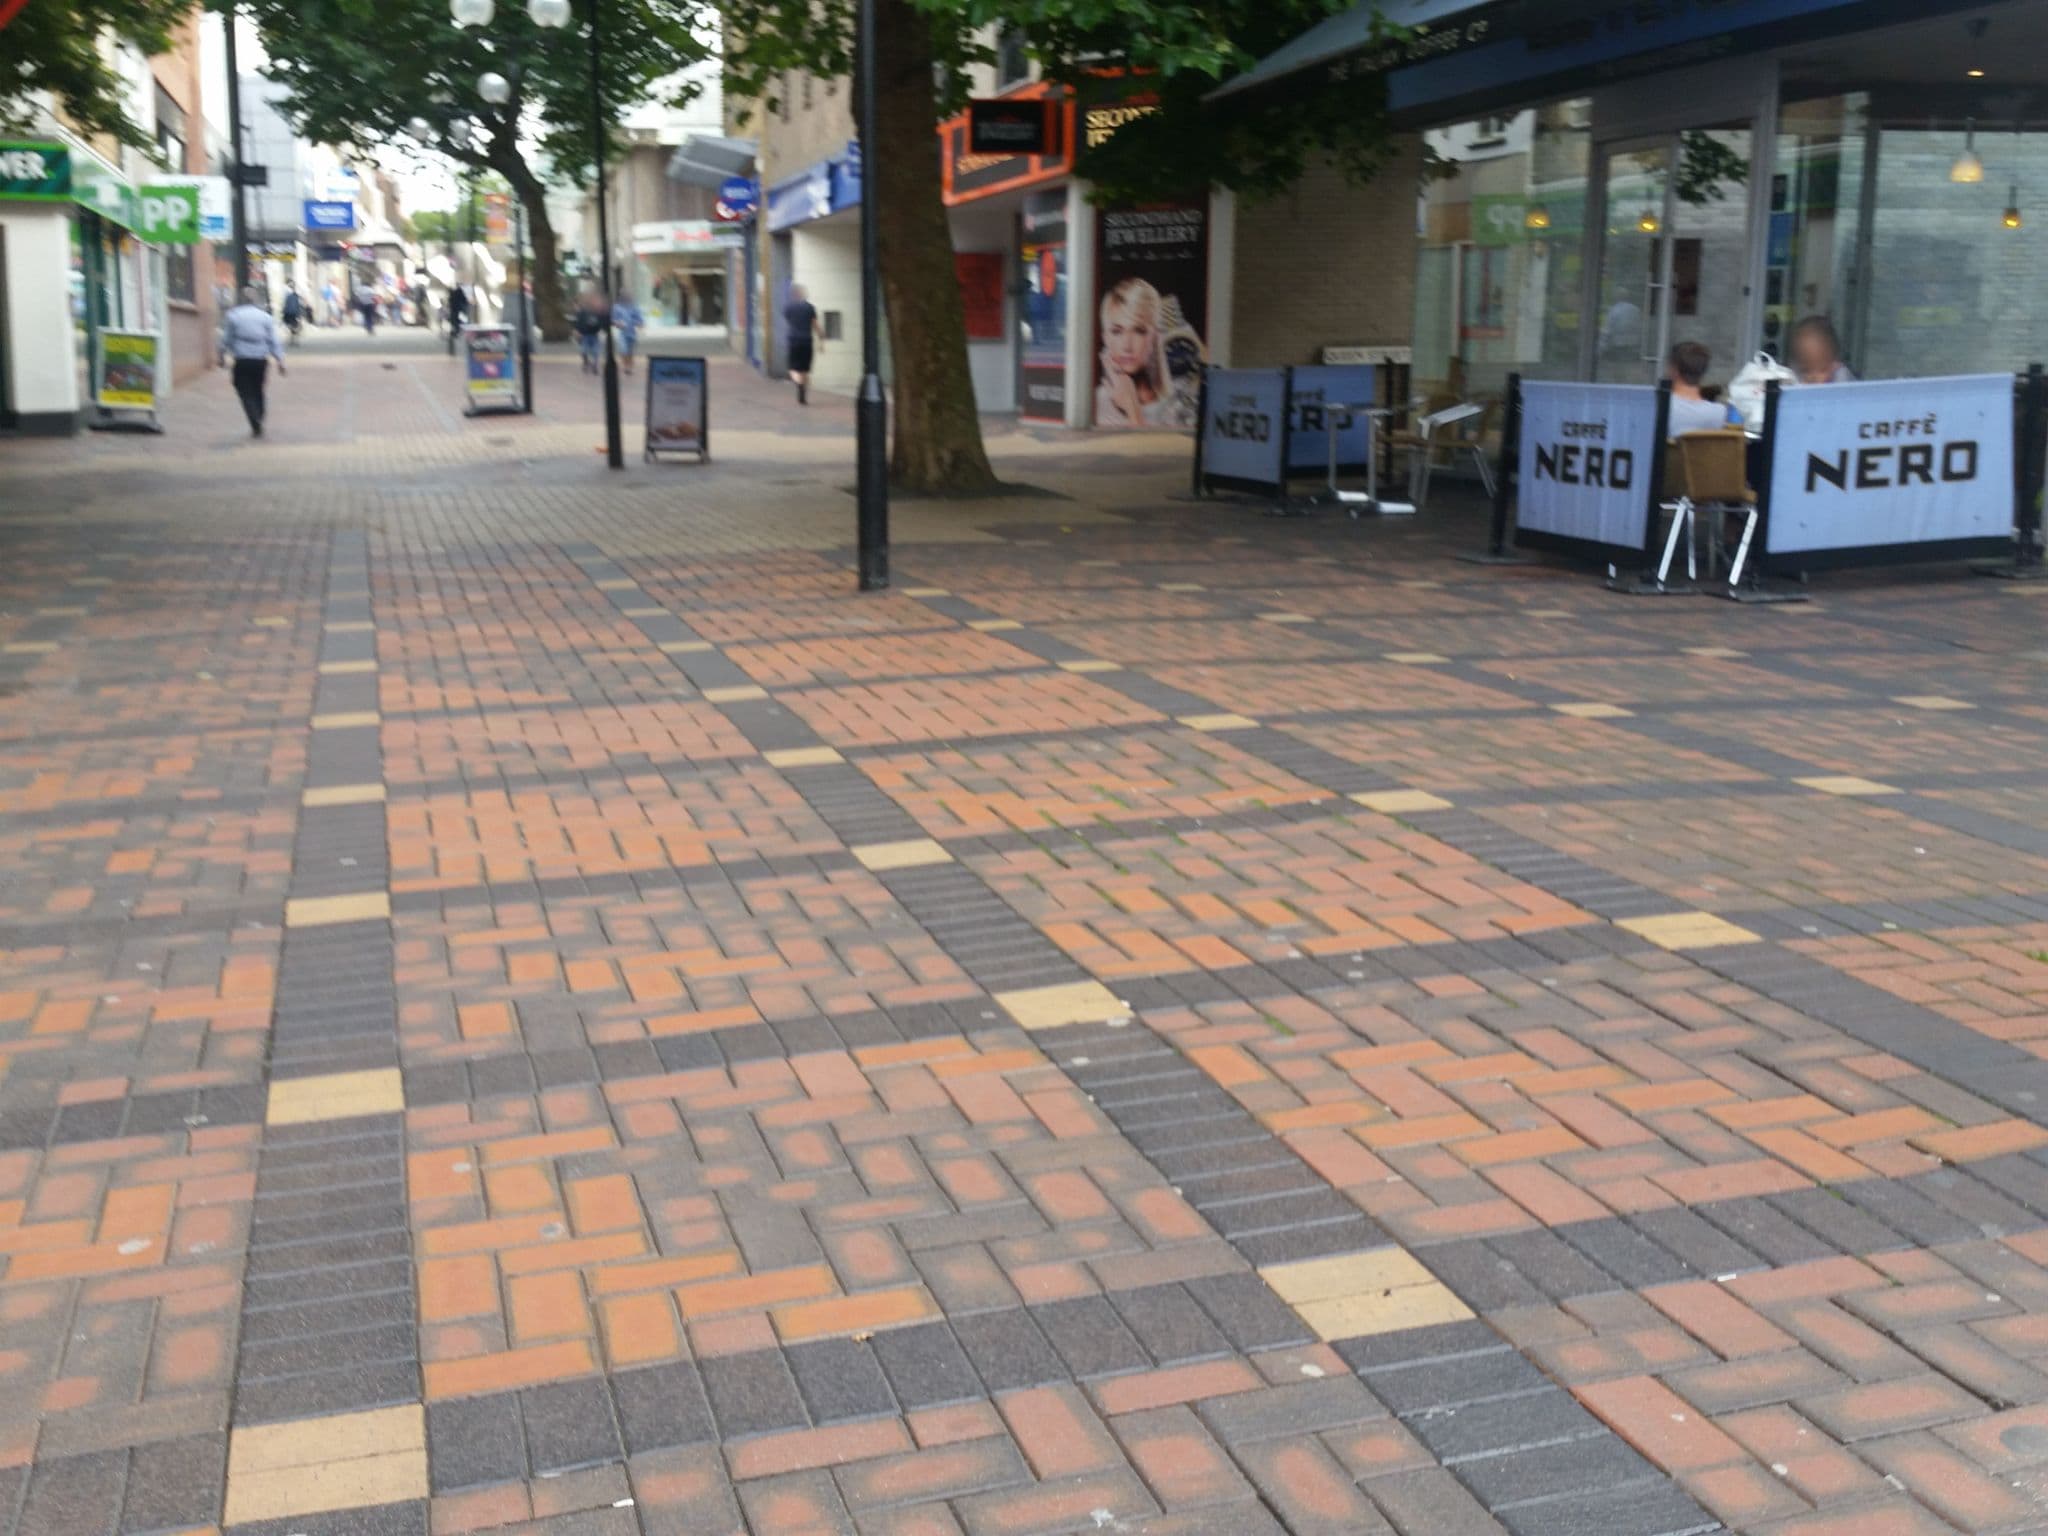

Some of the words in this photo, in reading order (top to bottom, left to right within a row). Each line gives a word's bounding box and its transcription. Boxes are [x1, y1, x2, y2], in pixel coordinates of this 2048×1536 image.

[142, 196, 192, 233] PP
[1104, 225, 1199, 247] JEWELLERY
[1212, 410, 1270, 442] NERO
[1858, 411, 1937, 439] CAFFÈ
[1534, 440, 1633, 490] NERO
[1803, 440, 1979, 494] NERO
